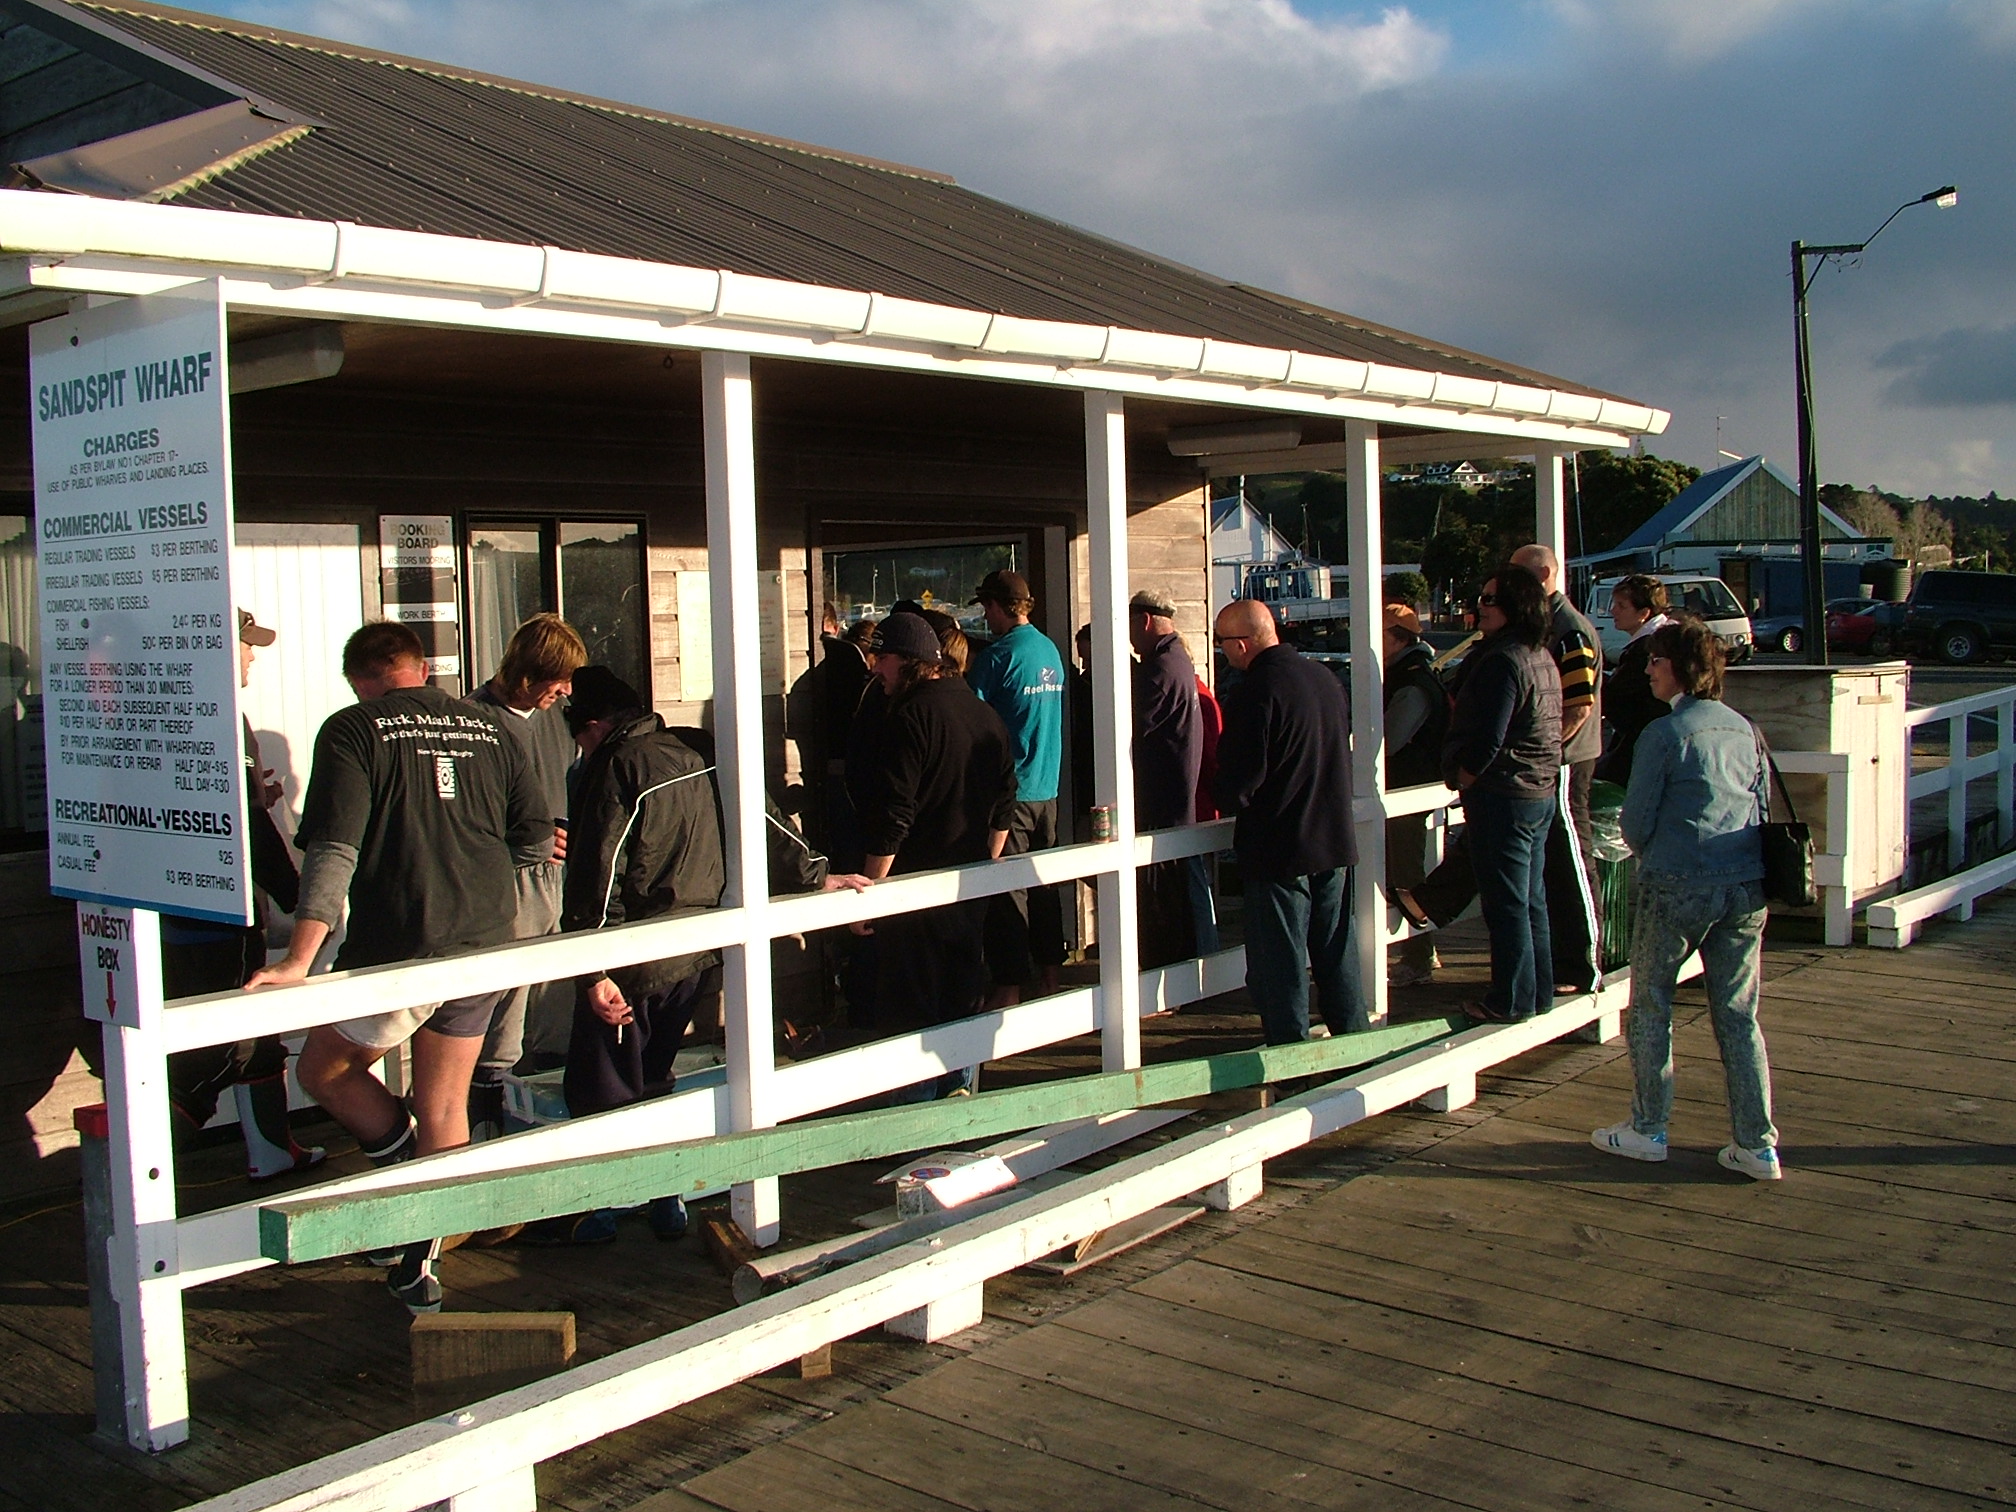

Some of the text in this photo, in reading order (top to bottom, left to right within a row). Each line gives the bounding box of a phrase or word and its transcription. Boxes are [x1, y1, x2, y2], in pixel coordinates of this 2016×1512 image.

[39, 352, 212, 422] SANDSPIT WHARF
[84, 428, 160, 457] CHARGES
[70, 465, 77, 475] AS
[80, 462, 92, 474] PER
[94, 459, 115, 473] BYLAW
[135, 453, 166, 467] CHAPTER
[48, 481, 60, 493] USE
[62, 479, 70, 491] OF
[72, 476, 94, 490] PUBLIC
[96, 472, 128, 487] WHARVES
[130, 470, 143, 482] AND
[146, 466, 176, 480] LANDING
[44, 501, 208, 539] COMMERCIAL VESSELS
[391, 524, 445, 536] BOOKING
[45, 539, 218, 565] REGULAR TRADING VESSELS $3 PER BERTHING
[398, 538, 438, 549] BOARD
[388, 556, 450, 564] VISITORS MOORING
[46, 566, 219, 589] IRREGULAR TRADING VESSELS $5 PER BERTHING
[47, 600, 86, 613] COMMERCIAL
[89, 598, 114, 611] FISHING
[56, 619, 69, 631] FISH
[192, 614, 207, 628] PER
[210, 614, 222, 628] KG
[398, 610, 419, 620] WORK
[56, 638, 89, 650] SHELLFISH
[159, 636, 173, 650] PER
[176, 636, 188, 650] BIN
[192, 636, 203, 650] OR
[206, 636, 222, 650] BAG
[50, 662, 193, 676] ANY VESSEL BERTHING USING THE WHARF
[50, 680, 62, 692] FOR
[64, 680, 70, 692] A
[72, 680, 96, 693] LONGER
[100, 680, 123, 694] PERIOD
[126, 681, 144, 694] THAN
[148, 681, 157, 694] 30
[60, 699, 218, 717] SECOND AND EACH SUBSEQUENT HALF HOUR
[72, 716, 84, 729] PER
[86, 717, 102, 730] HALF
[104, 718, 124, 732] HOUR
[127, 718, 137, 732] OR
[140, 719, 156, 732] PART
[160, 720, 194, 734] THEREOF
[442, 731, 474, 740] getting
[61, 735, 216, 756] BY PRIOR ARRANGEMENT WITH WHARFINGER
[62, 752, 74, 764] FOR
[76, 752, 121, 768] MAINTENANCE
[124, 756, 134, 769] OR
[138, 756, 162, 771] REPAIR
[175, 760, 194, 773] HALF
[175, 777, 194, 791] FULL
[58, 835, 96, 848] ANNUAL FEE
[58, 855, 96, 873] CASUAL FEE
[219, 850, 234, 865] $25
[166, 870, 235, 892] $3 PER BERTHING
[82, 913, 130, 942] HONESTY
[98, 946, 120, 971] BOX
